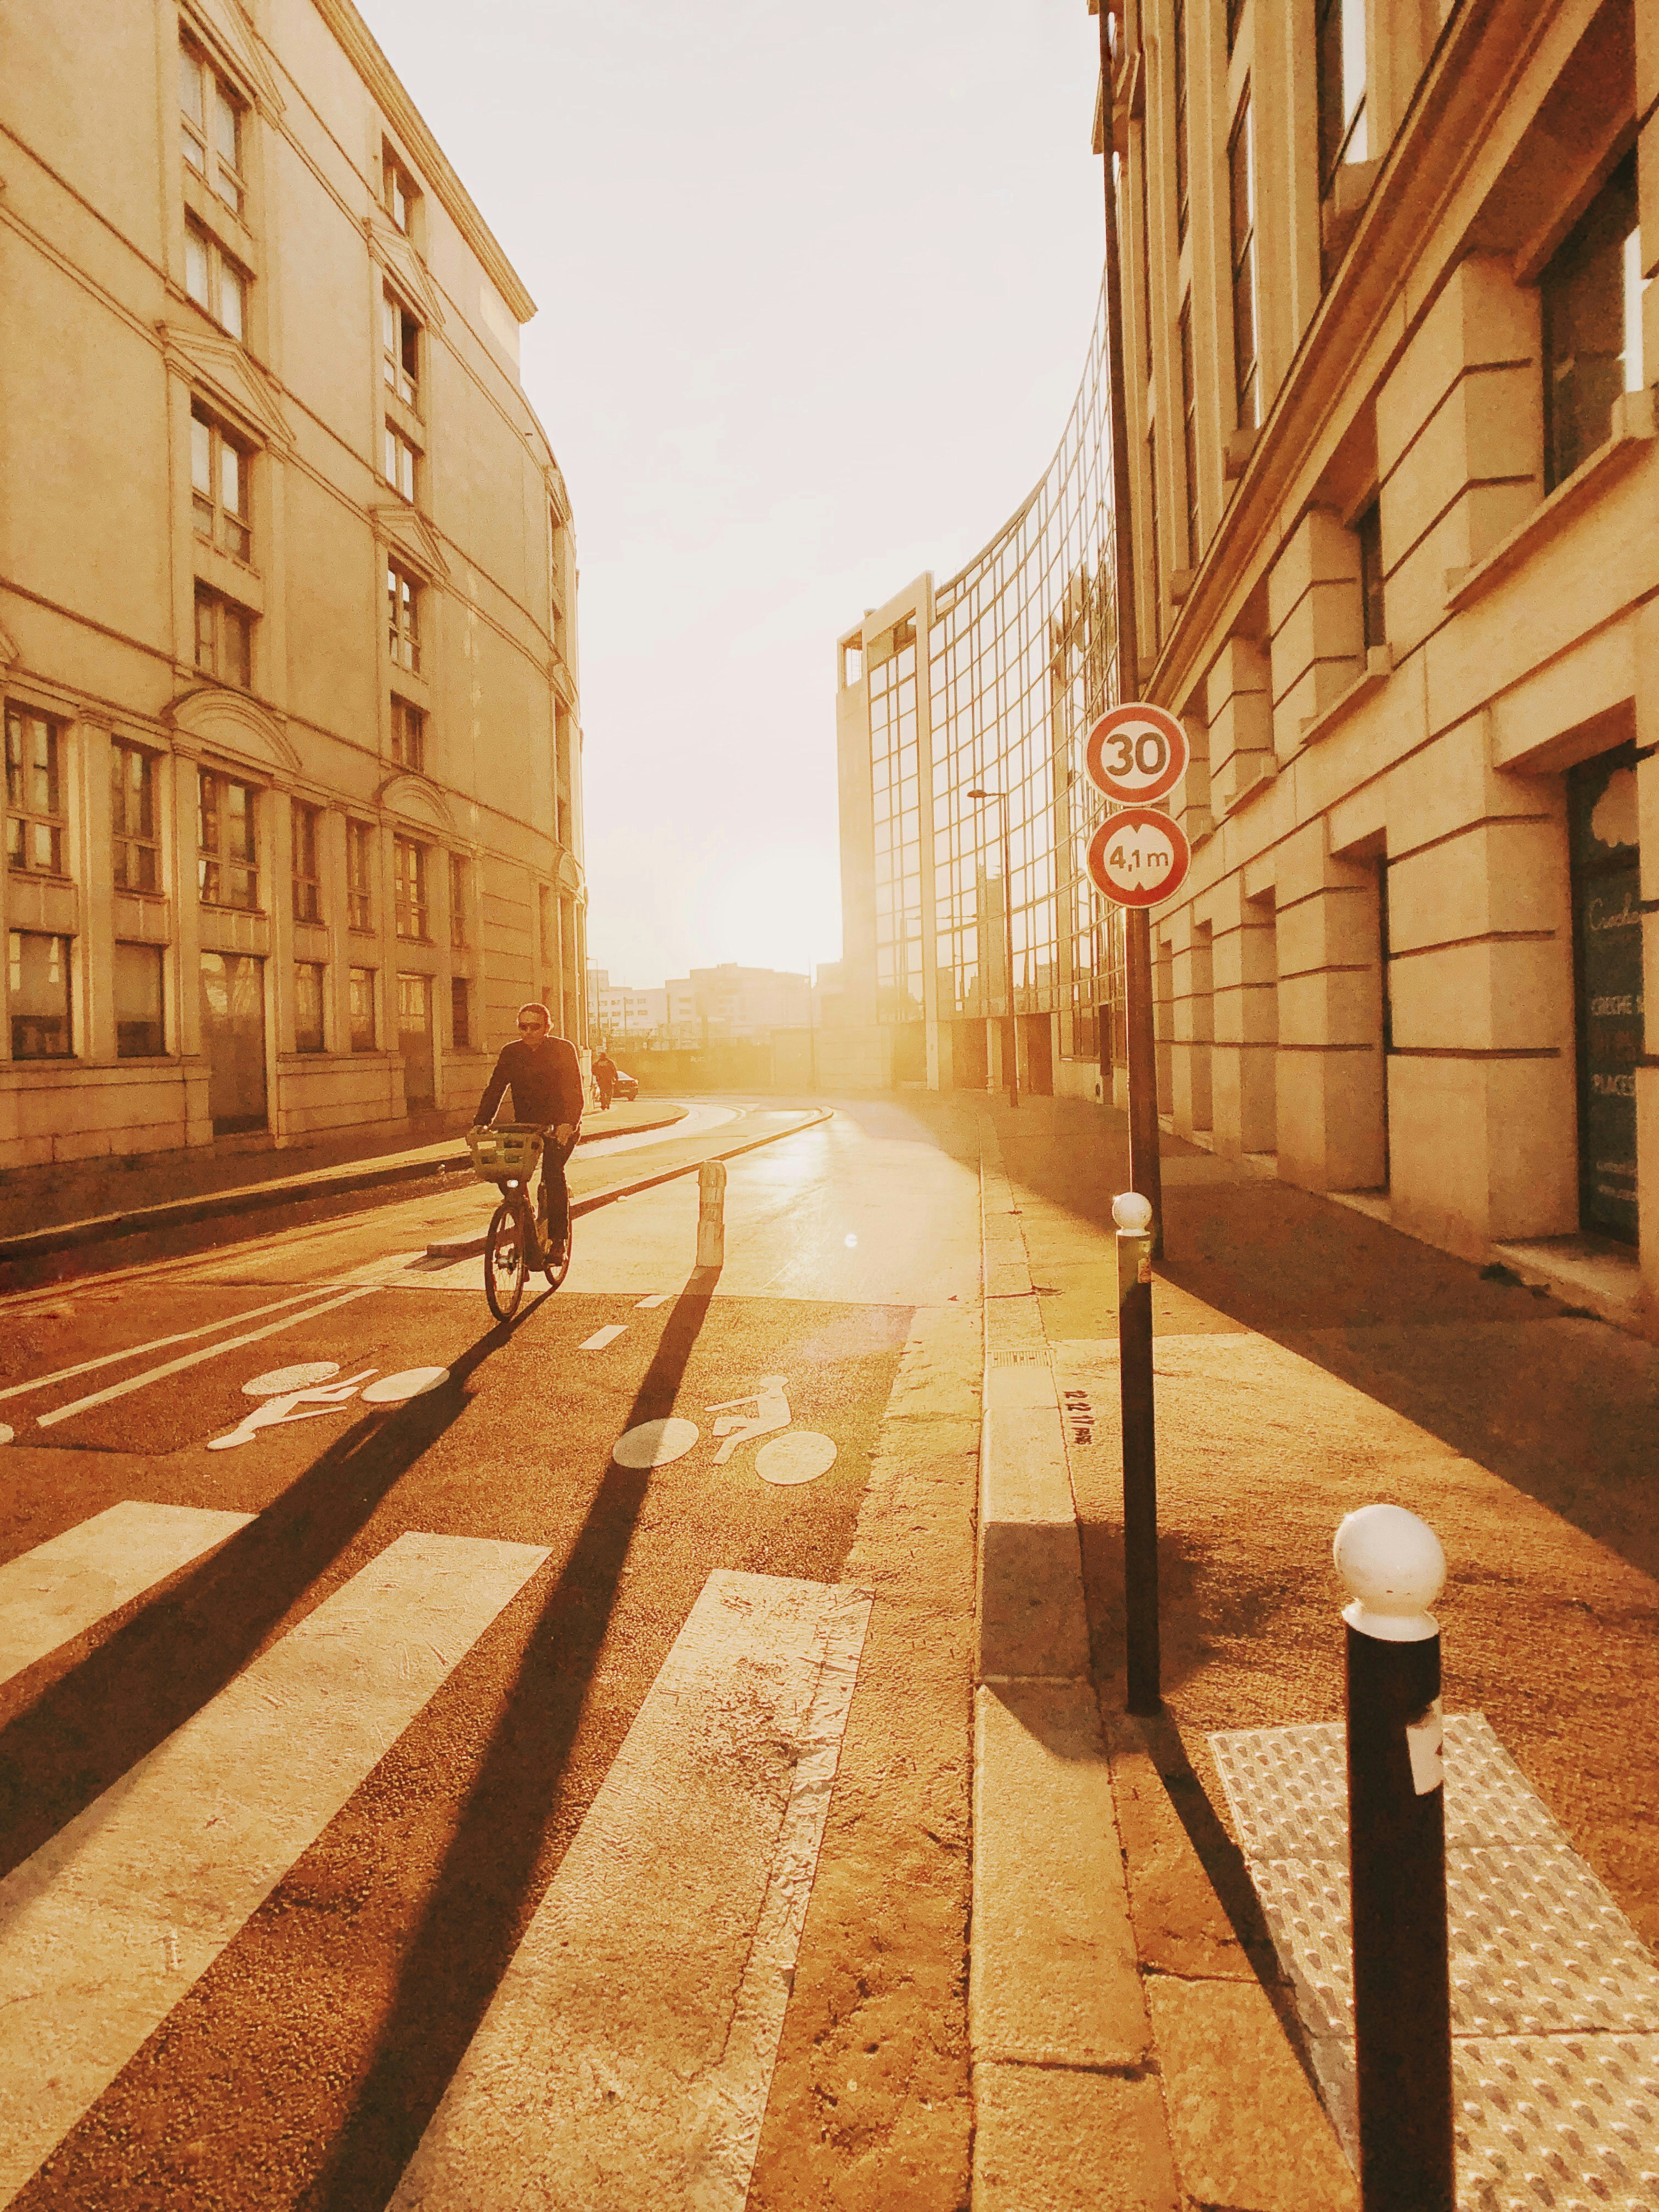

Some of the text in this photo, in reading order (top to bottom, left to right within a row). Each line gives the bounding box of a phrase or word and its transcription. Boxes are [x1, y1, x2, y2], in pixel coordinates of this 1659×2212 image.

[1106, 732, 1166, 776] 30
[1147, 852, 1169, 867] m
[1063, 1390, 1088, 1398] 12
[1065, 1402, 1091, 1411] 12
[1069, 1415, 1095, 1425] 17
